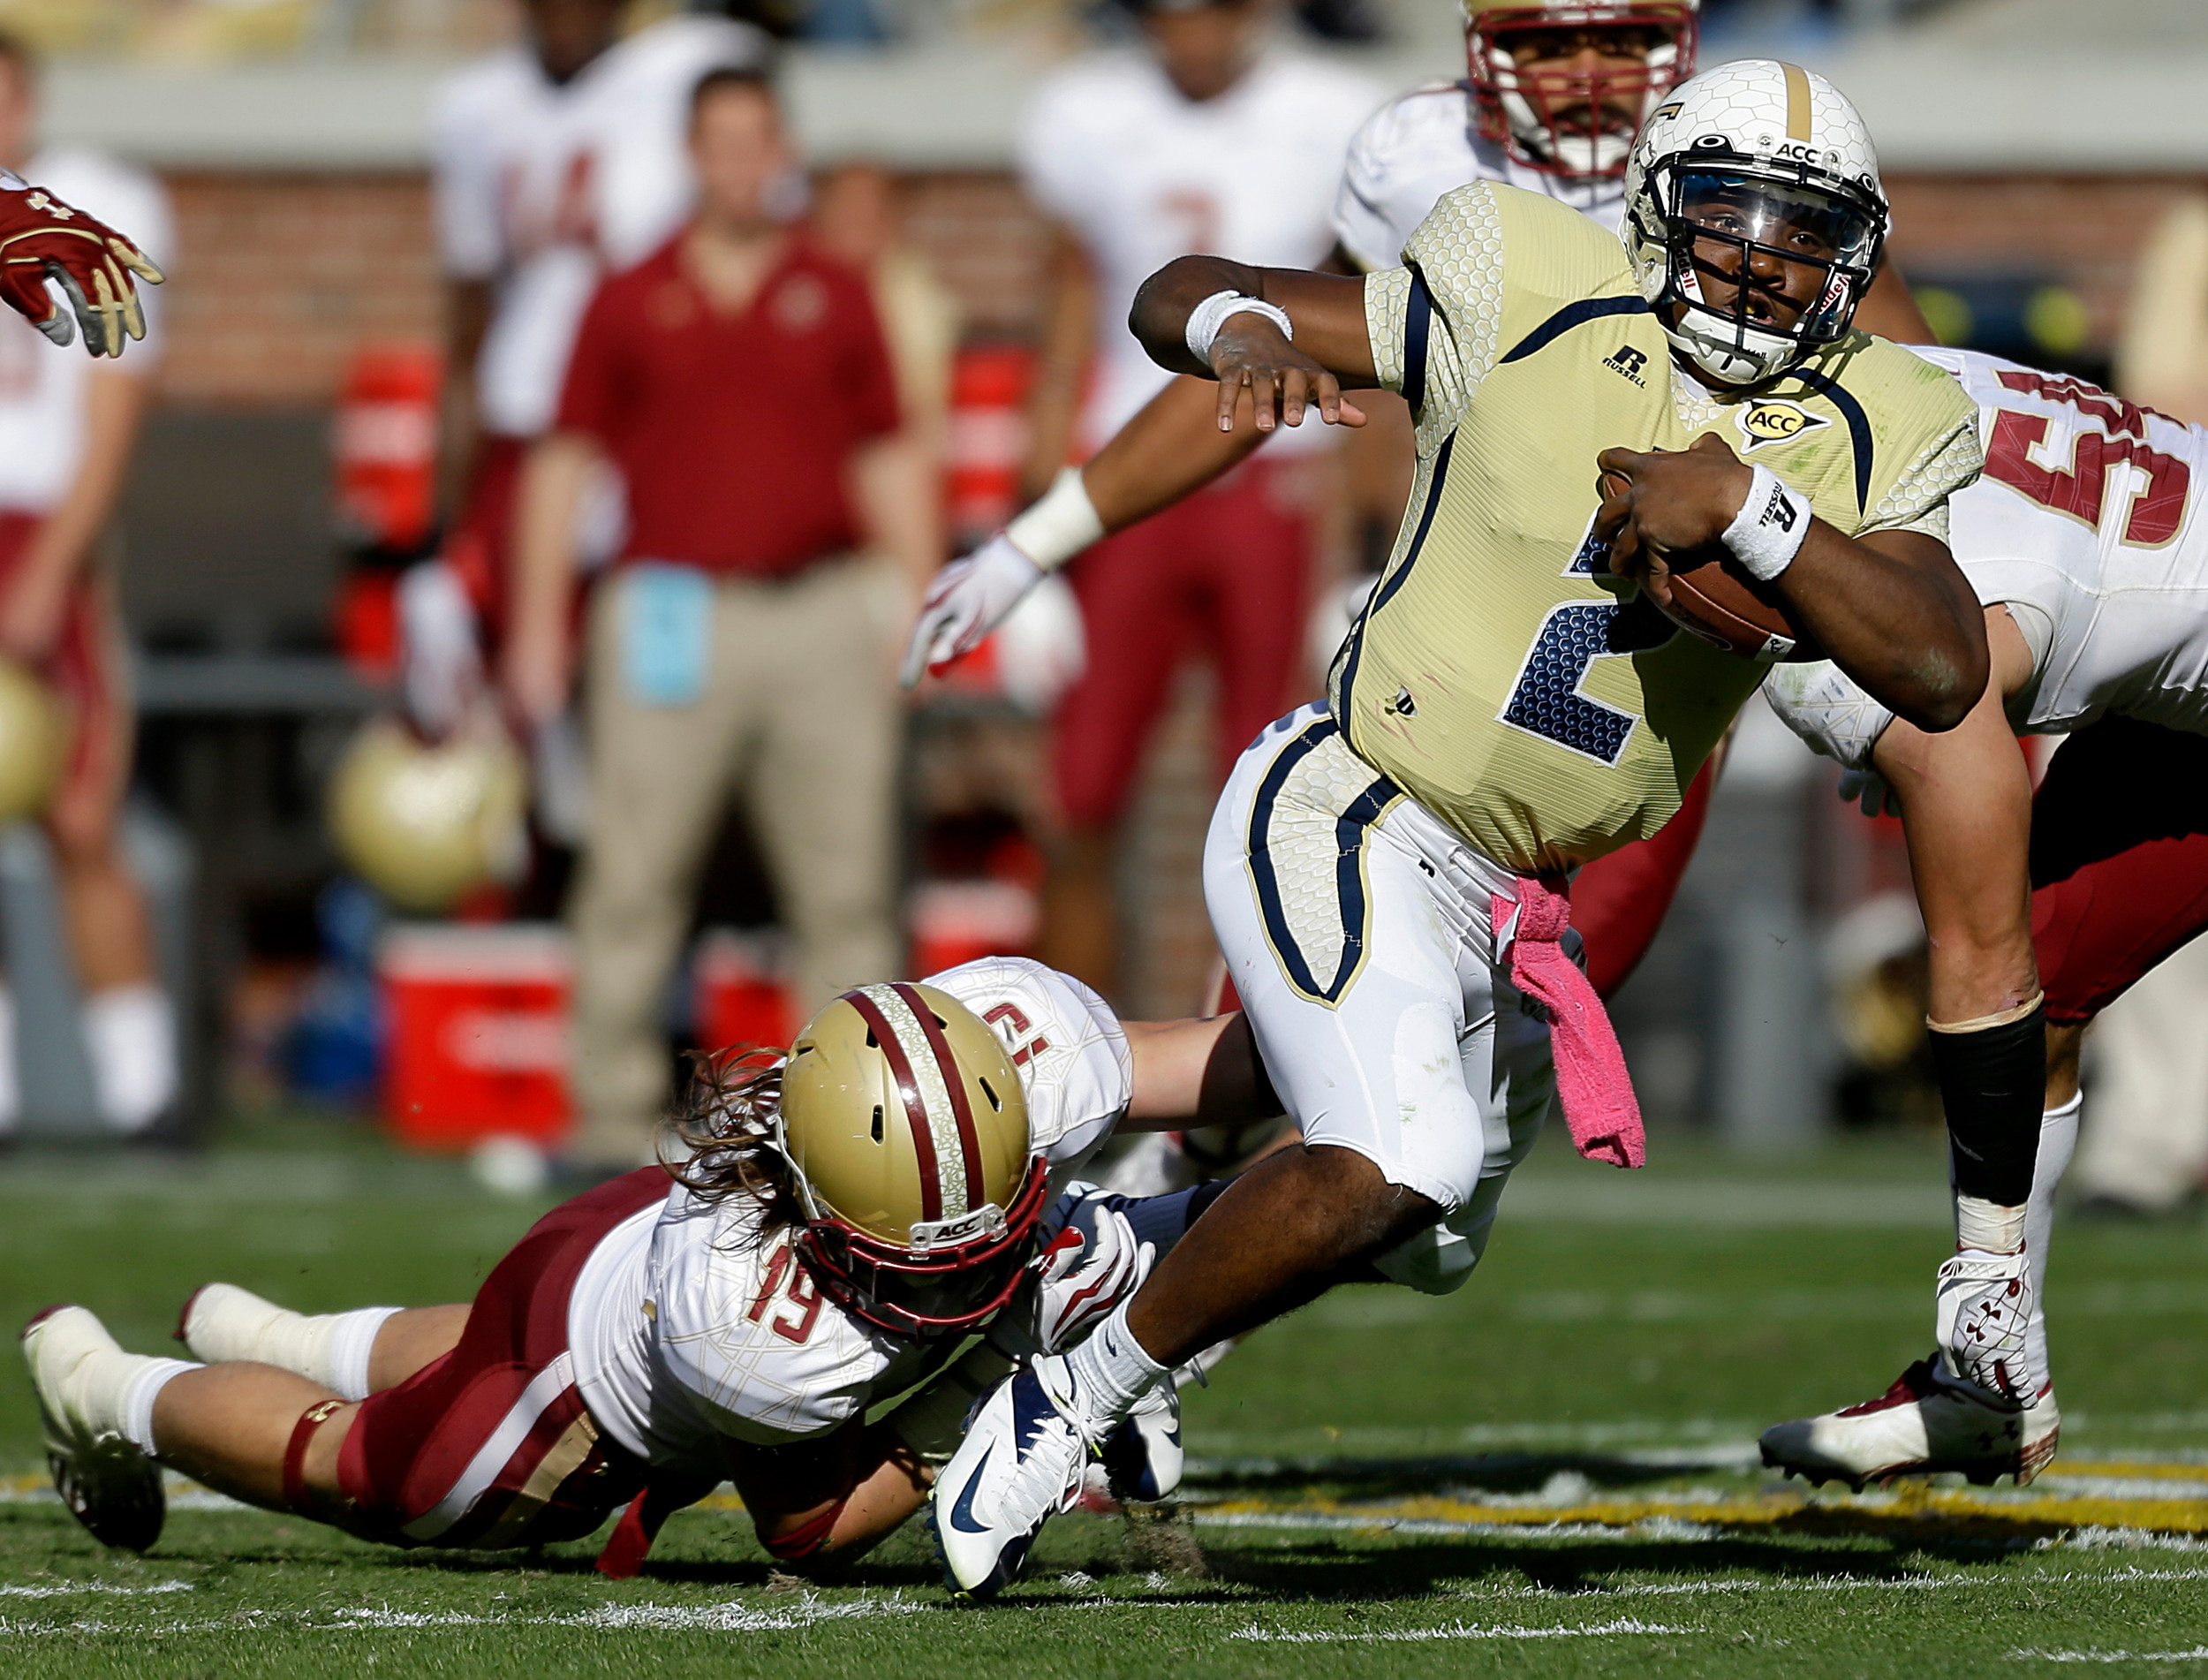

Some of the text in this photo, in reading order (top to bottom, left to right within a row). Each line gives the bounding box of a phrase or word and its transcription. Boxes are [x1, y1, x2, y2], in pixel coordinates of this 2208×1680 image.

[1775, 143, 1816, 163] ACC
[1602, 357, 1646, 390] RUSSELL
[1750, 411, 1797, 433] ACC
[1981, 369, 2193, 549] 54
[1758, 481, 1782, 527] RUSSELL
[934, 1215, 980, 1238] ACC
[743, 1243, 826, 1346] 19
